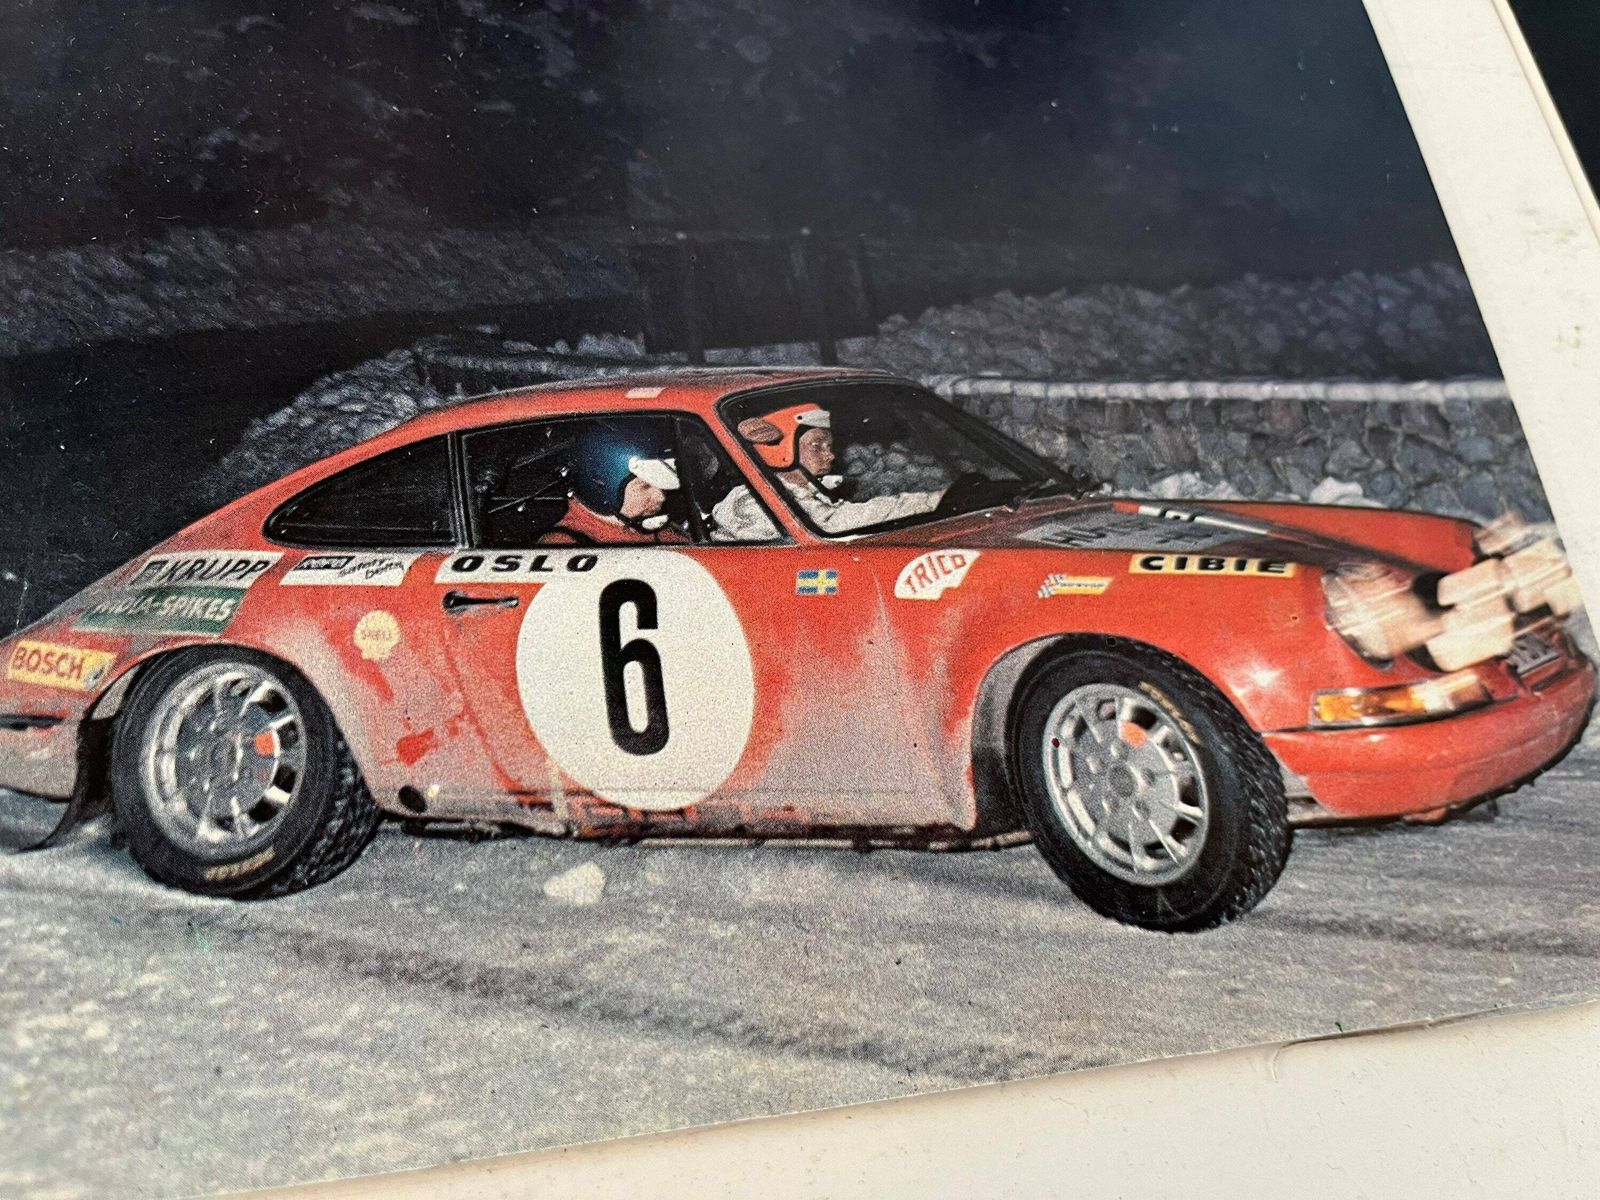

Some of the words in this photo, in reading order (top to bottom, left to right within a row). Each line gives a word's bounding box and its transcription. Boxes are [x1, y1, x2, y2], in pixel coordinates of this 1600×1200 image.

[157, 559, 270, 582] KRUPP
[450, 554, 599, 573] OSLO
[905, 554, 967, 594] TRICO
[1139, 556, 1287, 574] CIBIE
[11, 648, 85, 679] BOSCH
[599, 578, 670, 757] 6
